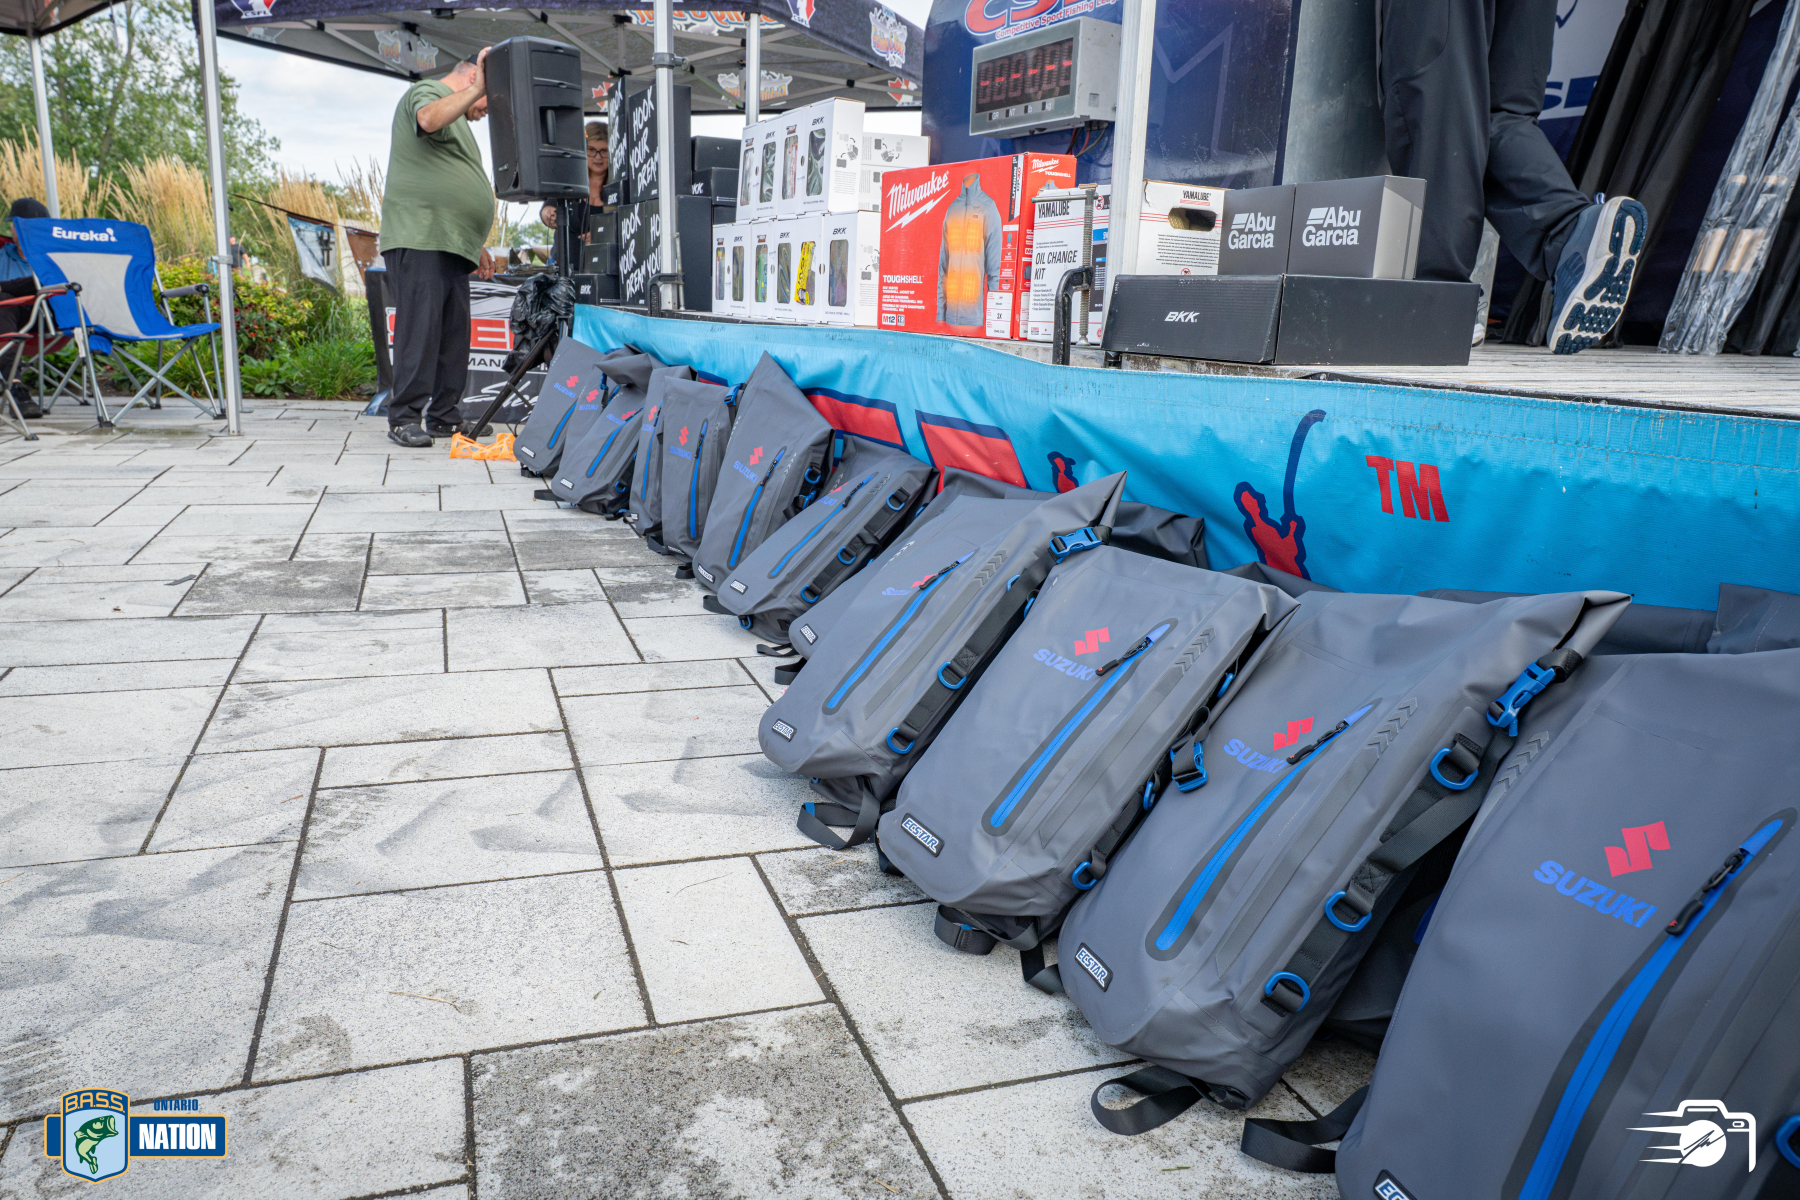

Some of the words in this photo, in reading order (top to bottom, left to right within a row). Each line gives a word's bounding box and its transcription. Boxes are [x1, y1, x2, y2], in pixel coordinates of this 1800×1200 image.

[792, 14, 810, 27] CSFL
[995, 19, 1040, 39] Competitive
[1041, 11, 1063, 25] Sport
[1065, 1, 1094, 17] Fishing
[633, 86, 655, 141] HOOK
[812, 117, 825, 125] BKK
[765, 131, 776, 139] BKK
[630, 127, 650, 179] YOUR
[608, 193, 618, 205] BKK
[1038, 200, 1070, 218] YAMALUBE
[622, 203, 641, 249] HOOK
[1244, 212, 1276, 232] Abu
[1323, 206, 1361, 228] Abu
[650, 214, 660, 247] HO
[832, 227, 848, 235] BKK
[1228, 230, 1274, 249] Garcia
[1302, 226, 1359, 247] Garcia
[620, 239, 637, 284] YOUR
[1035, 252, 1045, 265] OIL
[1047, 250, 1078, 264] CHANGE
[626, 260, 646, 302] DREAM
[882, 275, 923, 284] TOUGHSHELL
[1034, 268, 1046, 280] KIT
[580, 285, 592, 295] BKK
[883, 316, 896, 324] M12
[1164, 311, 1200, 323] BKK
[554, 383, 576, 399] SUZUKI
[669, 445, 692, 460] SUZUKI
[733, 461, 759, 484] SUZUKI
[1366, 455, 1450, 522] TM
[1033, 648, 1096, 681] SUZUKI
[774, 721, 793, 738] ECSTAR
[1223, 738, 1288, 774] SUZUKI
[903, 819, 938, 852] ECSTAR
[1533, 860, 1658, 928] SUZUKI
[1076, 948, 1109, 985] ECSTAR
